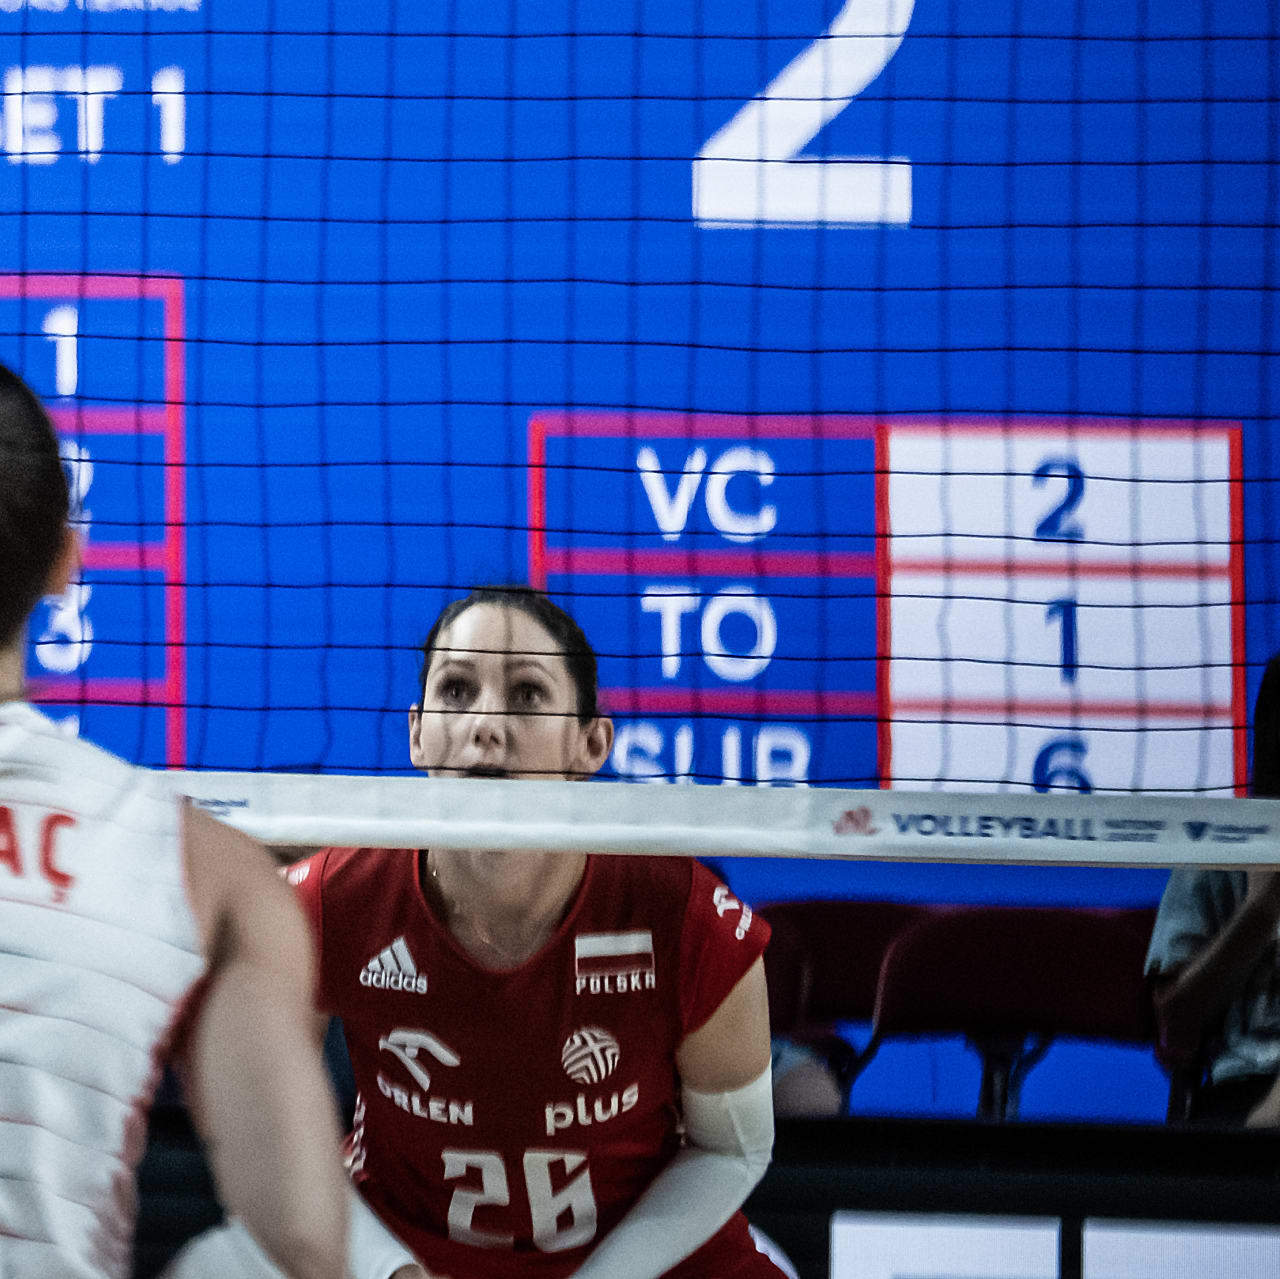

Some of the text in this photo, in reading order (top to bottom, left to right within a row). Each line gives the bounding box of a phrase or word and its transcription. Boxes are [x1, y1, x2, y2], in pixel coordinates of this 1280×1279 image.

[150, 63, 187, 165] 1
[42, 303, 79, 401] 1
[637, 446, 1085, 543] VC 2
[640, 586, 1078, 684] TO 1
[891, 813, 1098, 842] VOLLEYBALL
[359, 969, 428, 995] adidas
[576, 972, 656, 995] POLSKA
[376, 1071, 474, 1126] ORLEN
[545, 1082, 640, 1137] plus
[441, 1148, 598, 1253] 26
